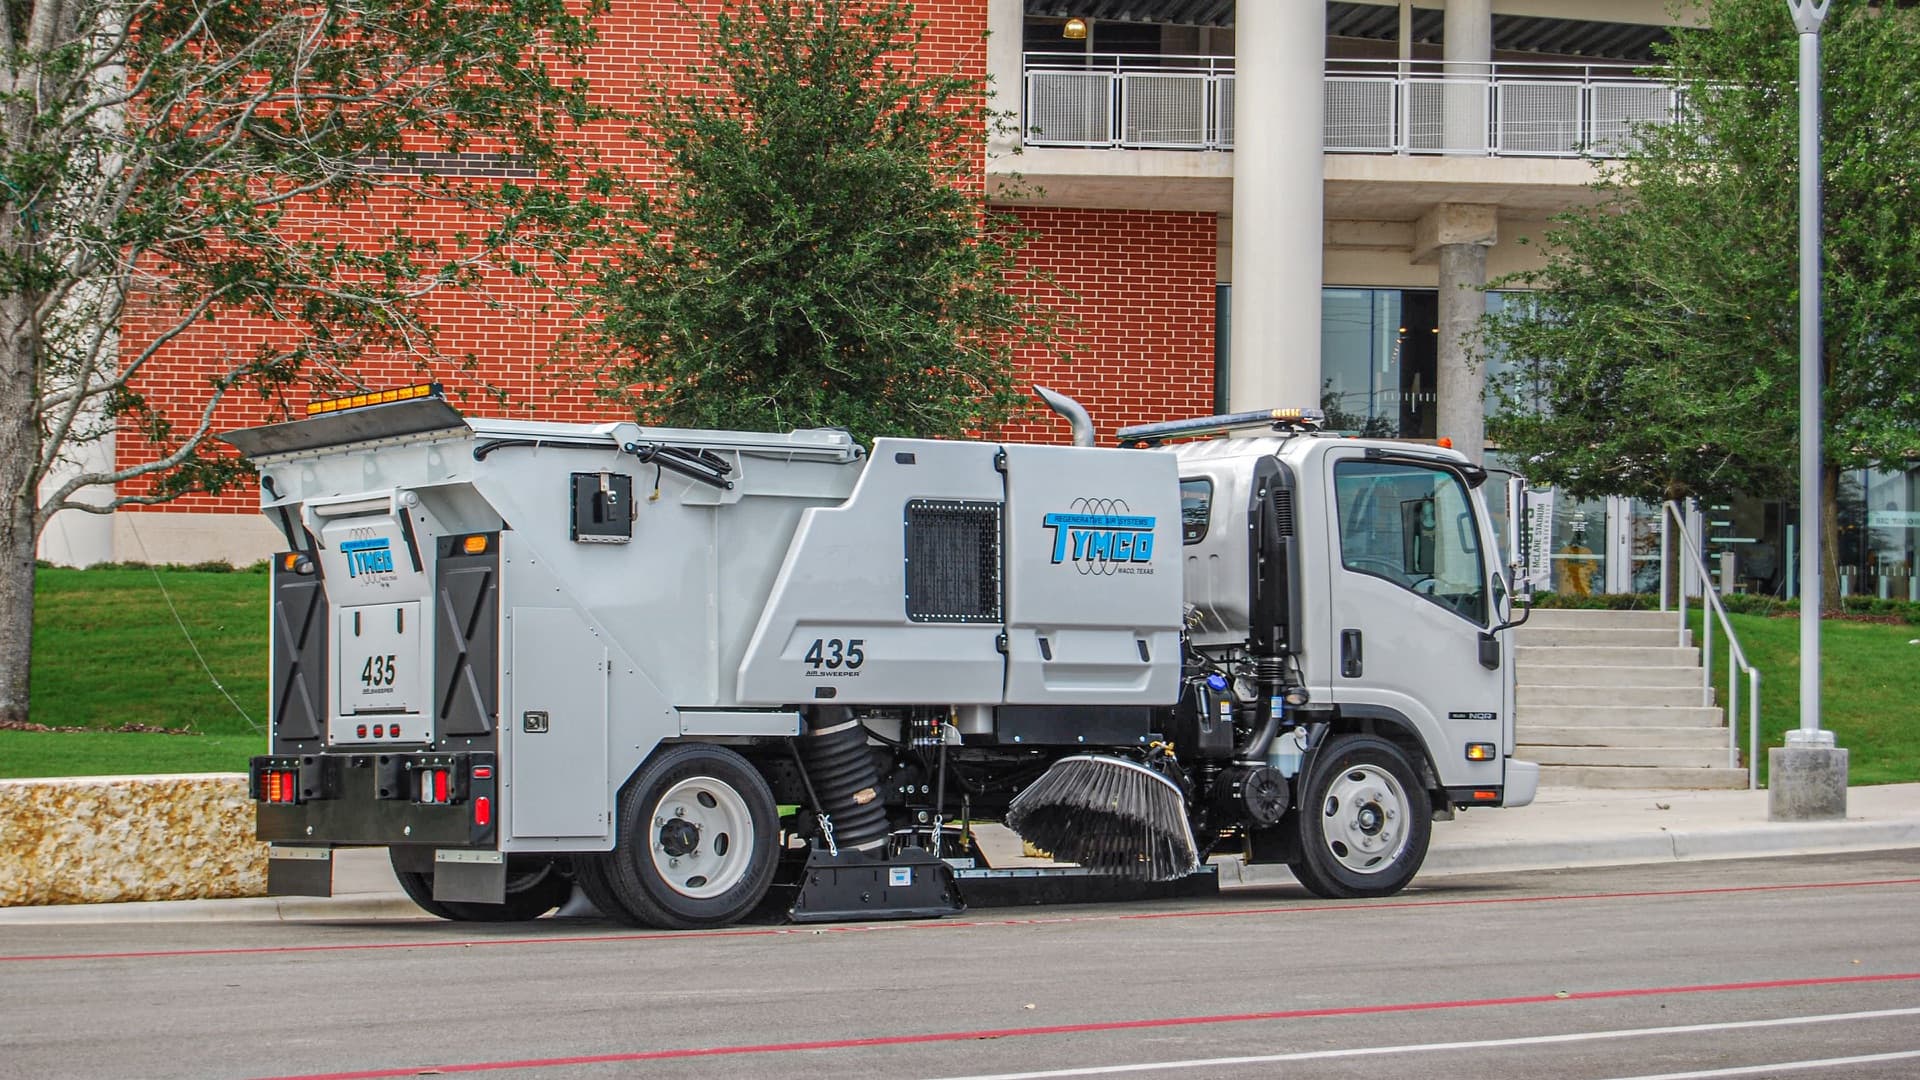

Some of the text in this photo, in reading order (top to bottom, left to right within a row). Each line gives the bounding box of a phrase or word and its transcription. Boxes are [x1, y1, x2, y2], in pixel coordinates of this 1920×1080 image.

[1055, 515, 1102, 524] REGENERATIVE
[1118, 518, 1148, 526] SYSTEMS
[1535, 503, 1545, 535] STADIUM
[1043, 512, 1156, 563] TYMCO
[1532, 538, 1542, 568] McLANE
[1136, 567, 1154, 575] TEXAS
[804, 638, 864, 669] 435
[361, 654, 396, 686] 435
